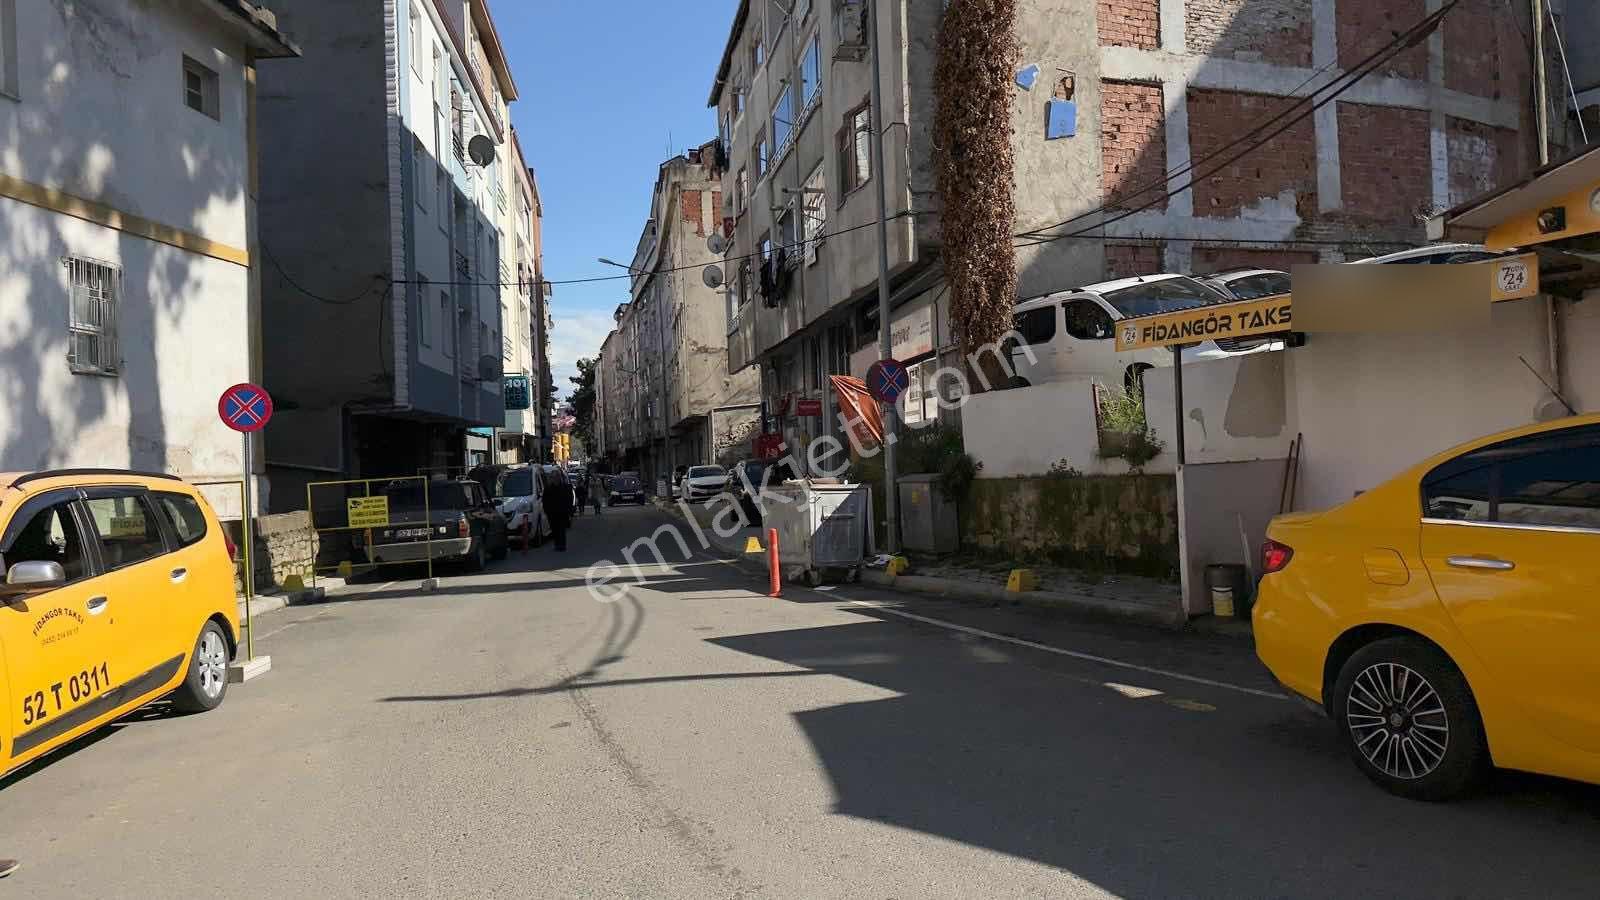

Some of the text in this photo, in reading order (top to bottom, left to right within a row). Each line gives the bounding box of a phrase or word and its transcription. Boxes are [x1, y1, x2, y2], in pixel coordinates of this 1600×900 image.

[1142, 312, 1232, 343] FİDANGÖR
[23, 661, 110, 725] 52 T 0311
